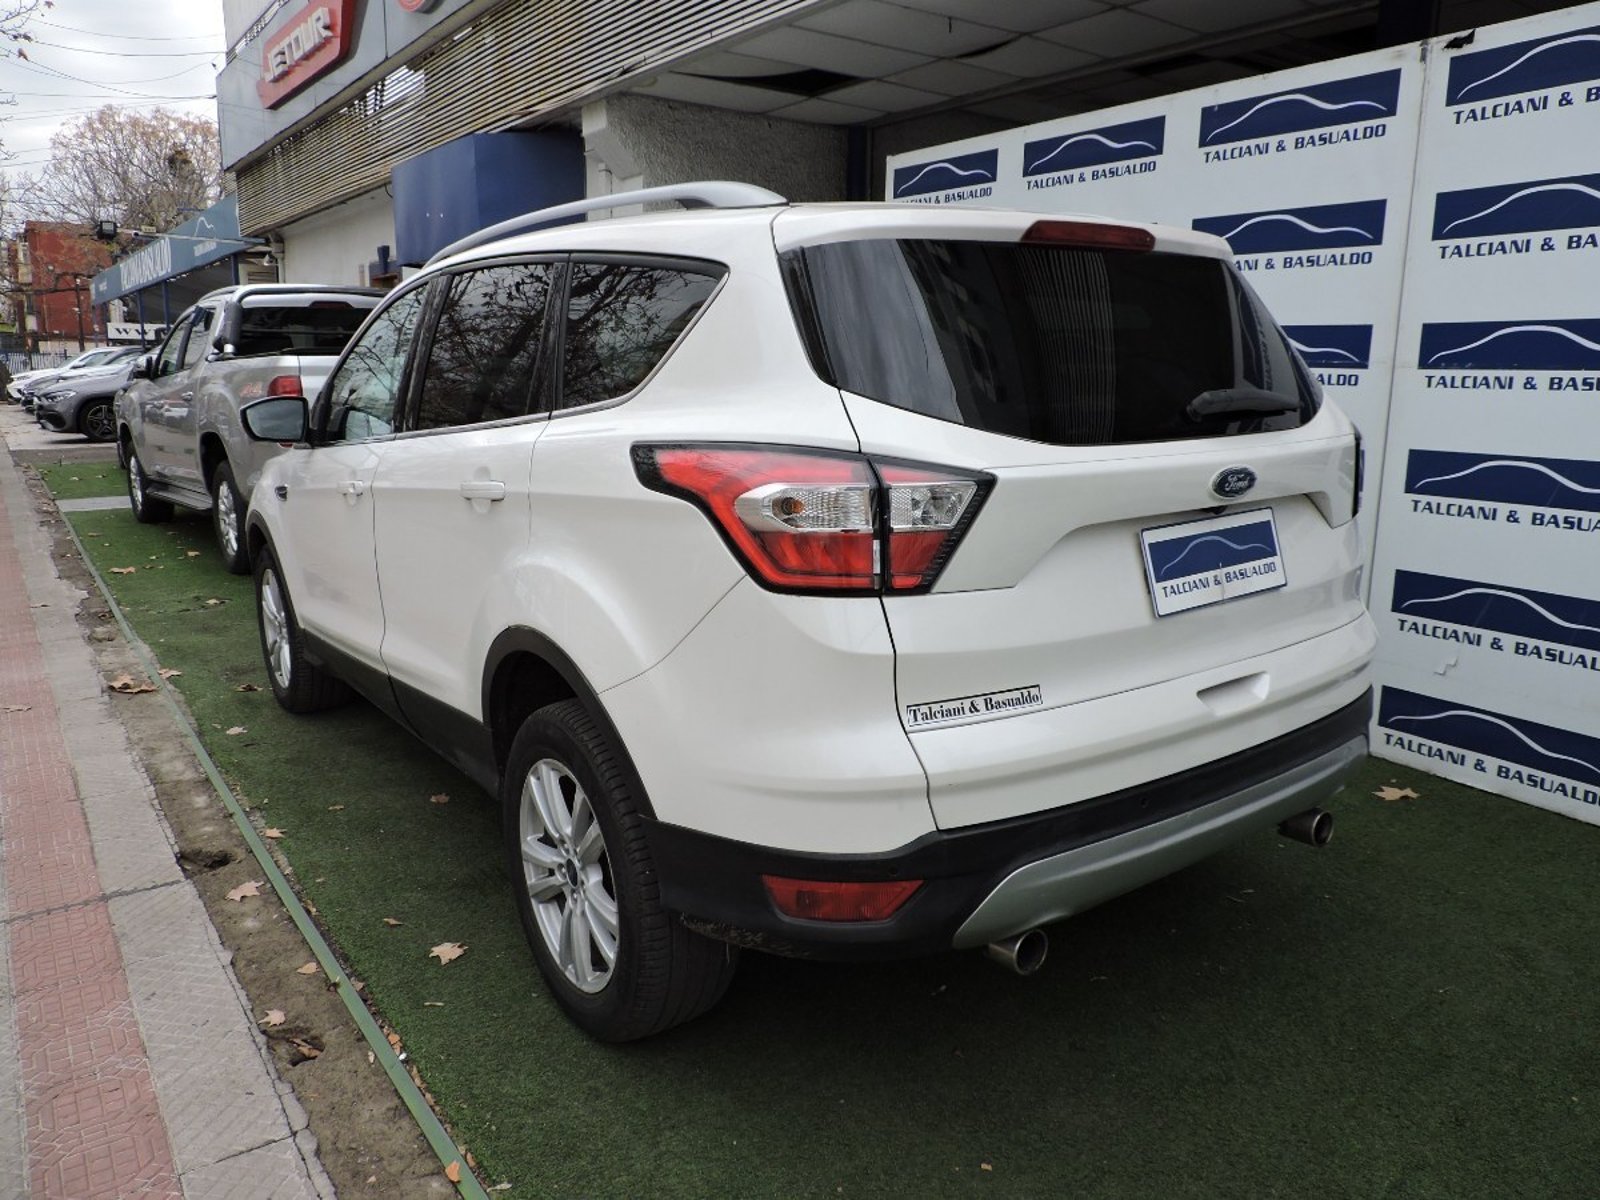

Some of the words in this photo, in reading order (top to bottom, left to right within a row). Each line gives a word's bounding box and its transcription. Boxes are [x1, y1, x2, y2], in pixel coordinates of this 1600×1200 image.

[264, 6, 333, 83] JETOUR
[1453, 95, 1548, 125] TALCIANI
[1558, 91, 1574, 107] &
[1203, 142, 1270, 163] TALCIANI
[1275, 139, 1287, 152] &
[1294, 124, 1387, 150] BASUALDO
[1026, 173, 1074, 191] TALCIANI
[1078, 168, 1087, 183] &
[1091, 160, 1157, 182] BASUALDO
[944, 186, 992, 203] BASUALDO
[1264, 258, 1276, 270] &
[1283, 251, 1373, 269] BASUALDO
[1439, 238, 1531, 260] TALCIANI
[1540, 236, 1555, 251] &
[1424, 375, 1514, 390] TALCIANI
[1523, 376, 1538, 390] &
[1548, 376, 1600, 392] BAS
[1224, 474, 1250, 491] Ford
[1411, 499, 1498, 521] TALCIANI
[1506, 510, 1520, 523] &
[1162, 577, 1210, 598] TALCIANI
[1213, 574, 1222, 586] &
[1224, 561, 1277, 583] BASUALDO
[1398, 618, 1482, 647] TALCIANI
[1490, 636, 1504, 651] &
[908, 701, 966, 722] Talciani
[968, 699, 980, 714] &
[983, 690, 1040, 712] Basualdo
[1384, 732, 1466, 767] TALCIANI
[1474, 758, 1487, 773] &
[1496, 764, 1600, 807] BASUALD
